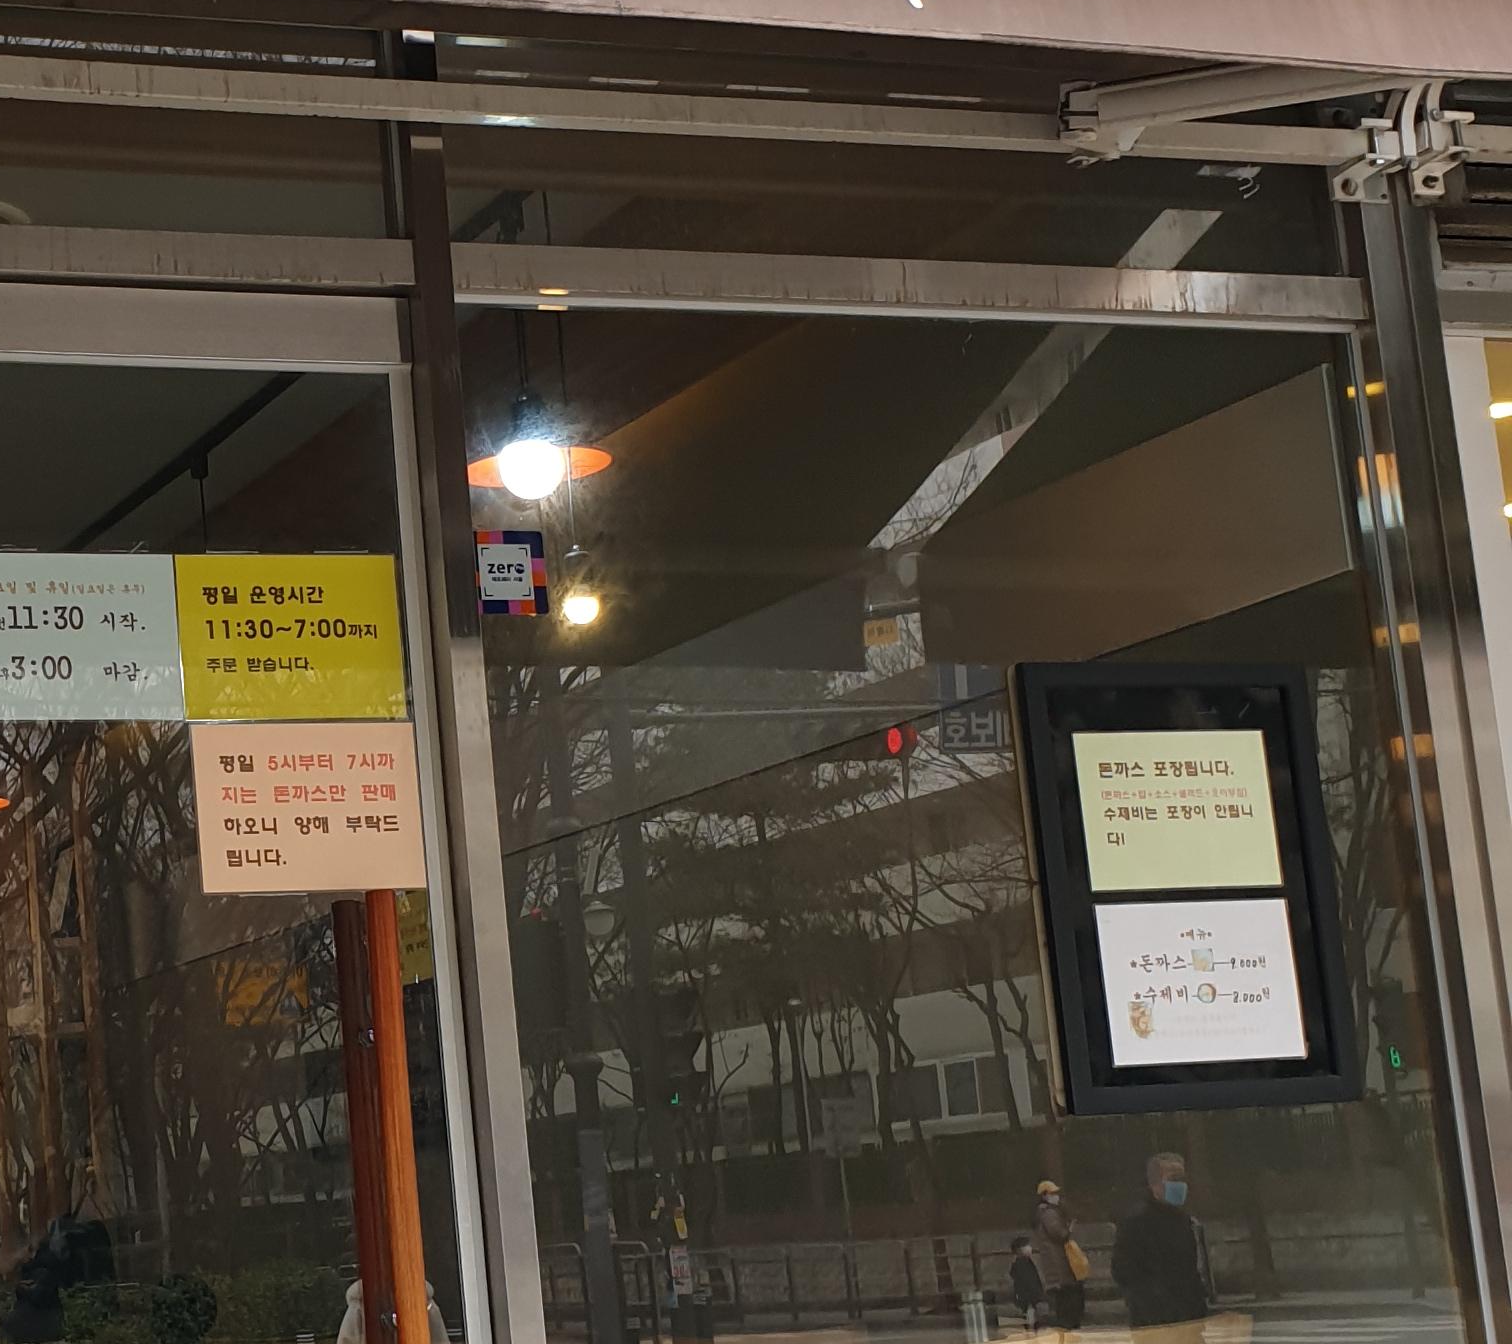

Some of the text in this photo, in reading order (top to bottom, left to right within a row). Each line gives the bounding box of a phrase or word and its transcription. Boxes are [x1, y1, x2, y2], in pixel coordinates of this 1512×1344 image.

[202, 585, 324, 605] 평일 운영시간
[100, 611, 146, 632] 시작.
[206, 657, 314, 673] 주문 받습니다.
[219, 753, 395, 773] 평일 5시부터 7시까
[1099, 762, 1145, 779] 돈까스
[221, 784, 396, 804] 지는 돈까스만 판매
[1104, 806, 1158, 822] 수제비는
[1167, 805, 1207, 820] 포장이
[224, 815, 400, 836] 하오니 양해 부탁드
[226, 849, 287, 868] 립니다.
[1139, 954, 1187, 973] 돈까스
[1143, 985, 1189, 1005] 수제비
